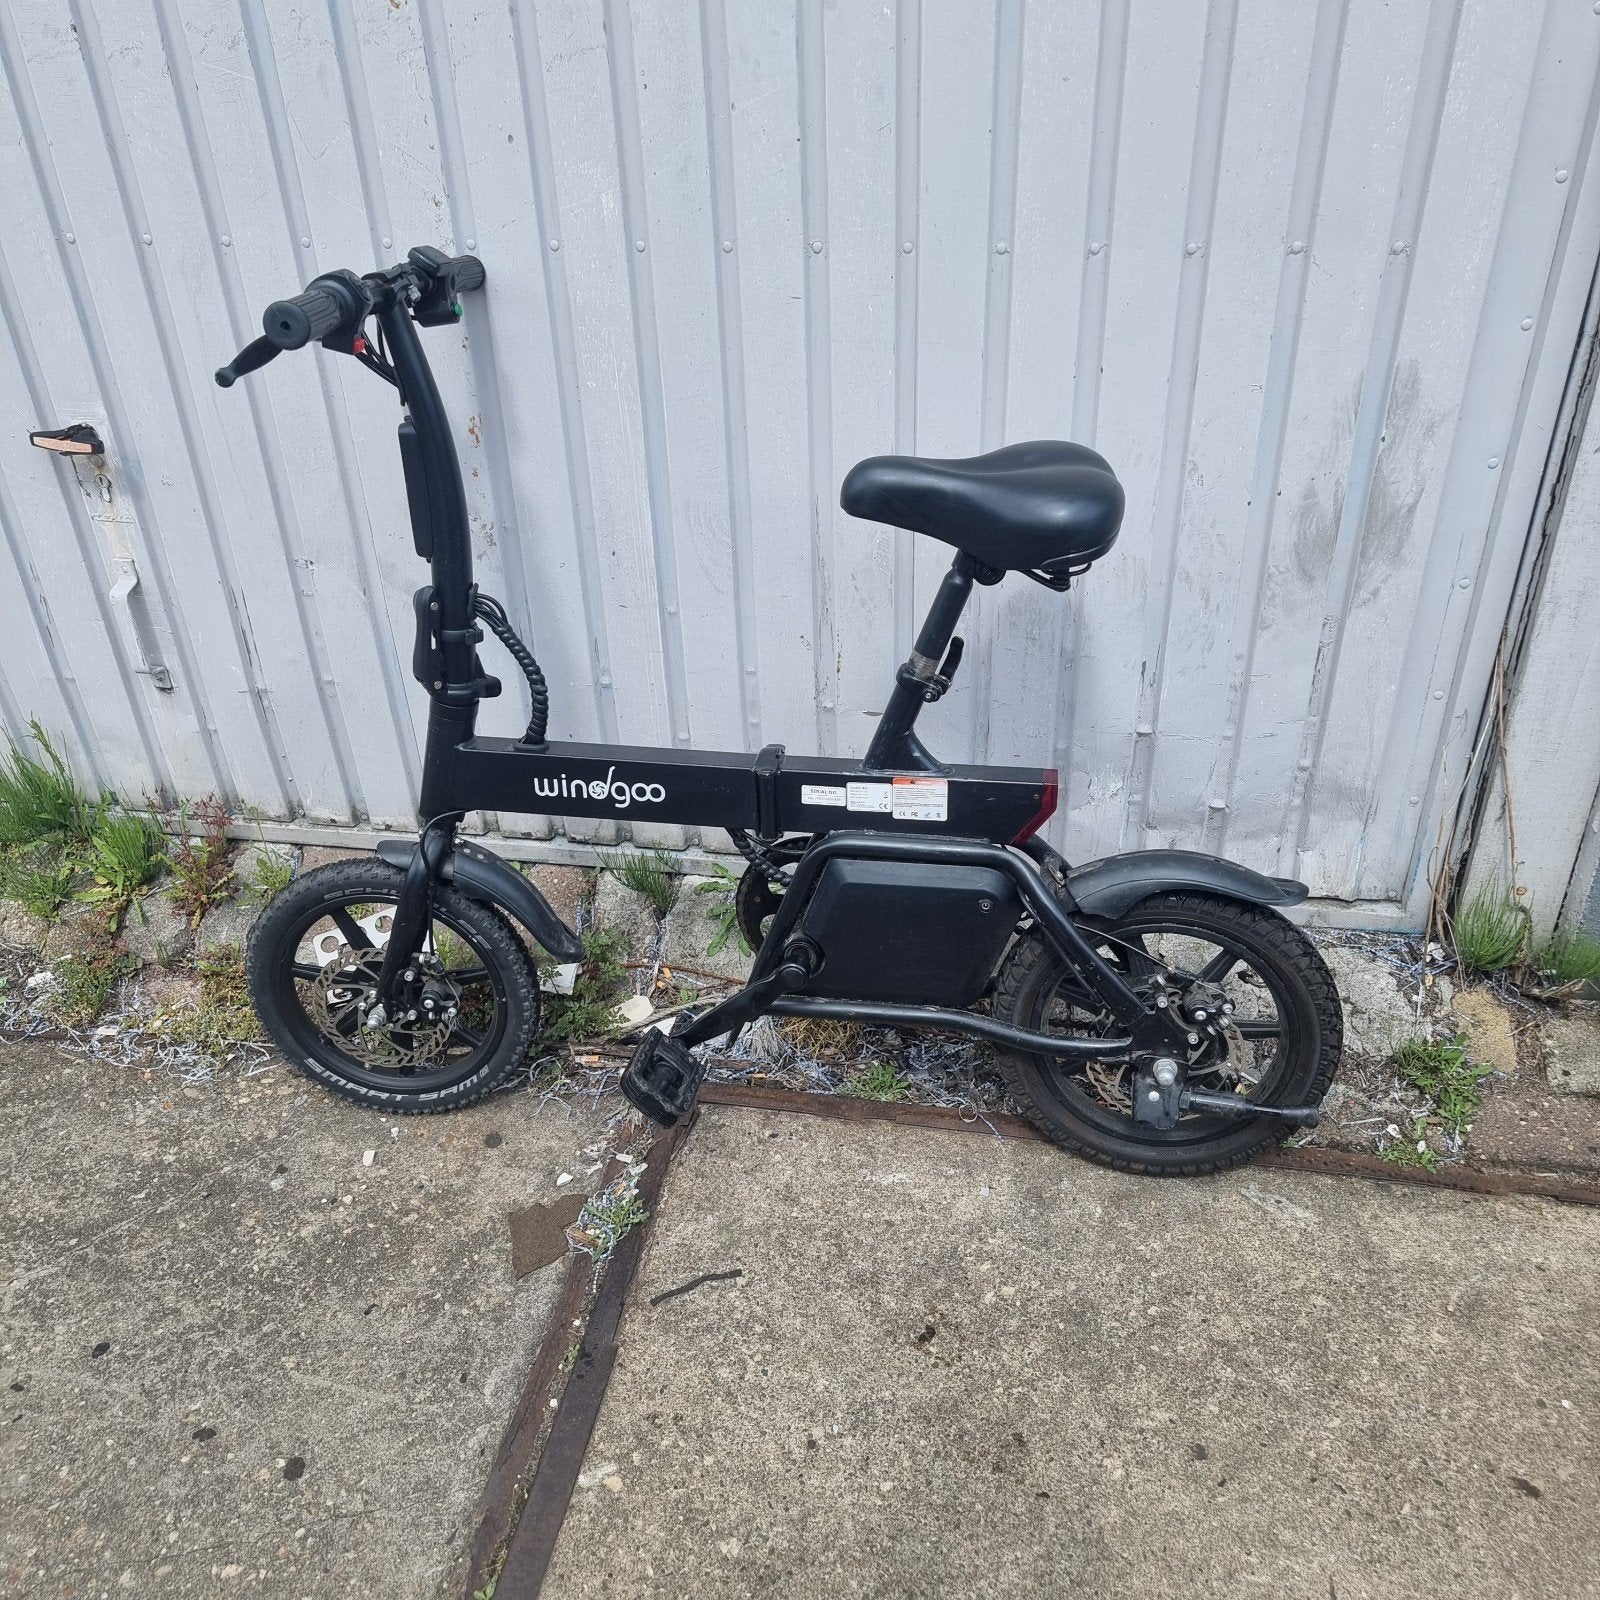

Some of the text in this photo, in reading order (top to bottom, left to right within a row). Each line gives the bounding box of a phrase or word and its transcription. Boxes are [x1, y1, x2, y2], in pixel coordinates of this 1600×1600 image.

[533, 765, 666, 808] windgoo
[303, 1056, 478, 1103] SMART SAM
